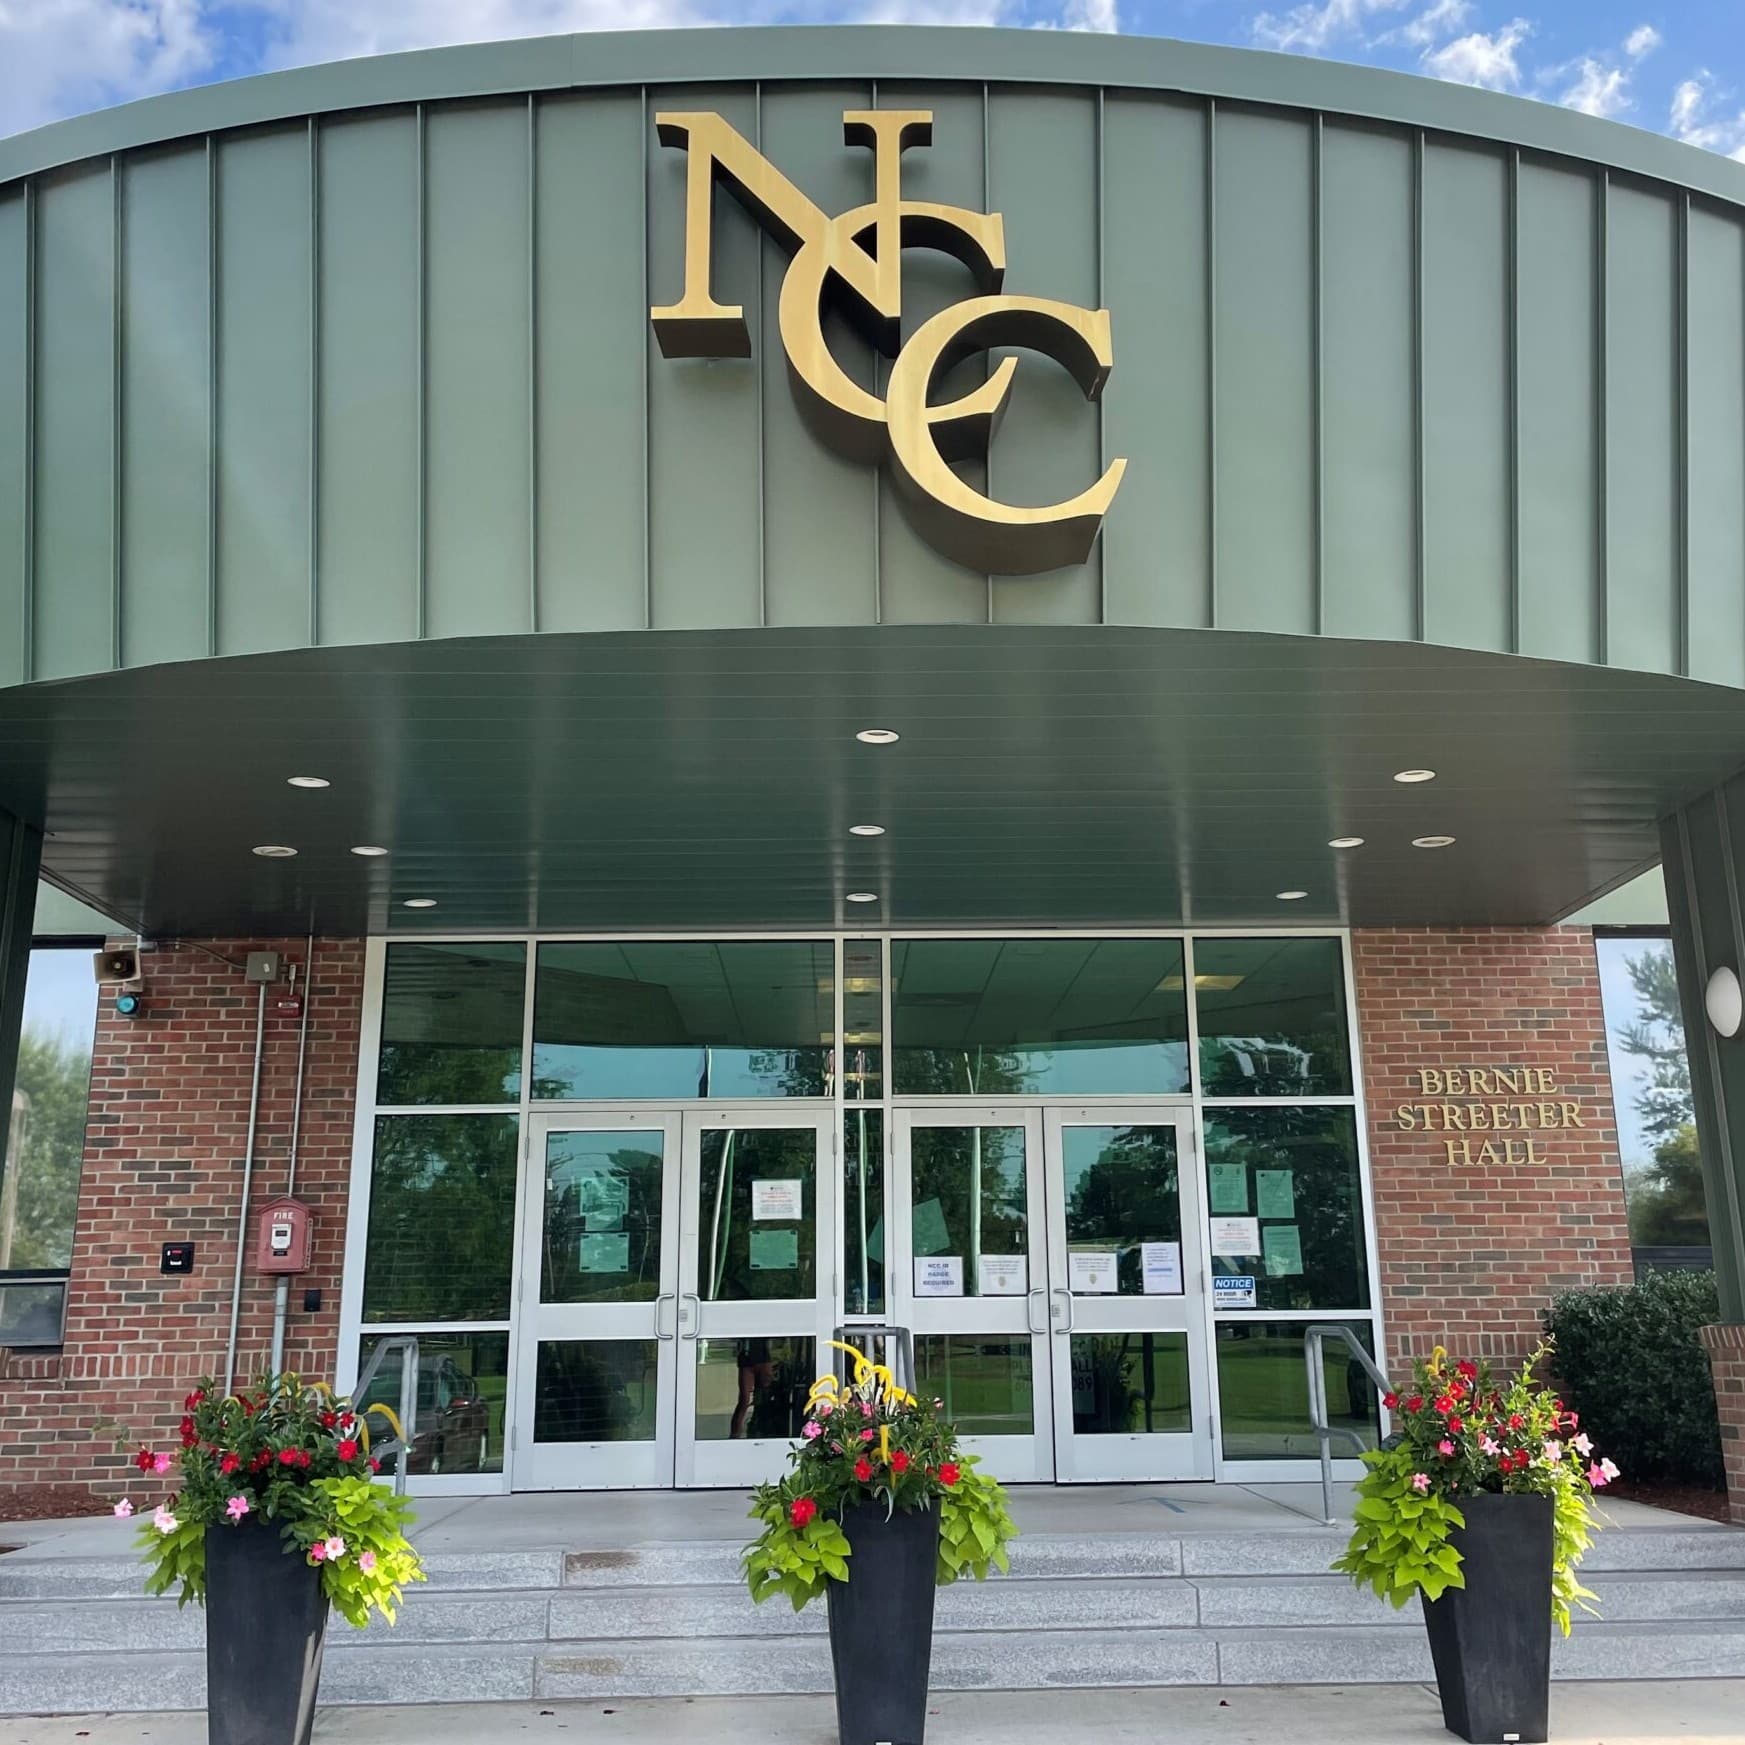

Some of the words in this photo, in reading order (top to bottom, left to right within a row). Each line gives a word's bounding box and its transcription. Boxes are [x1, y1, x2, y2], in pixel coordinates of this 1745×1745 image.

[650, 109, 1128, 526] NCC
[1418, 1068, 1558, 1095] BERNIE
[1397, 1102, 1585, 1130] STREETER
[1444, 1138, 1547, 1166] HALL
[273, 1212, 294, 1220] FIRE
[1215, 1279, 1252, 1288] NOTICE
